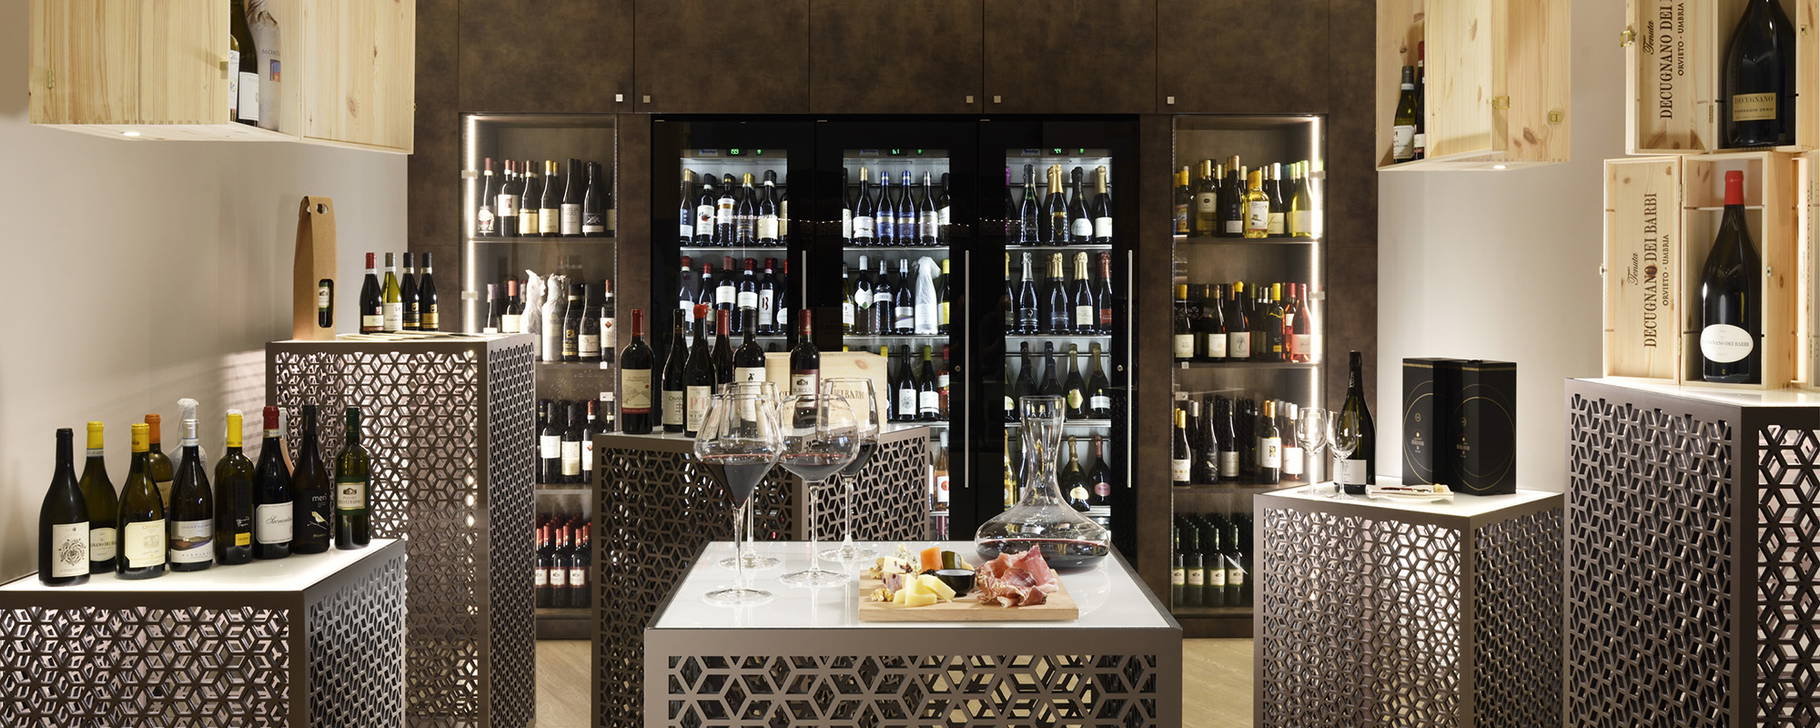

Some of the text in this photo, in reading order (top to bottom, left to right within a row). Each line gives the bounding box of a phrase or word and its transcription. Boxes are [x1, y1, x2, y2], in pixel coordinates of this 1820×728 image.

[1642, 20, 1654, 55] Tenuta
[1659, 5, 1673, 119] DECUGNANO DEI
[1677, 2, 1685, 76] ORVIETO UMBRIA
[1627, 252, 1639, 286] Tenuta
[1644, 193, 1658, 348] DECUGNANO DEI BARBI
[1662, 234, 1670, 306] ORVIETO UMBRIA
